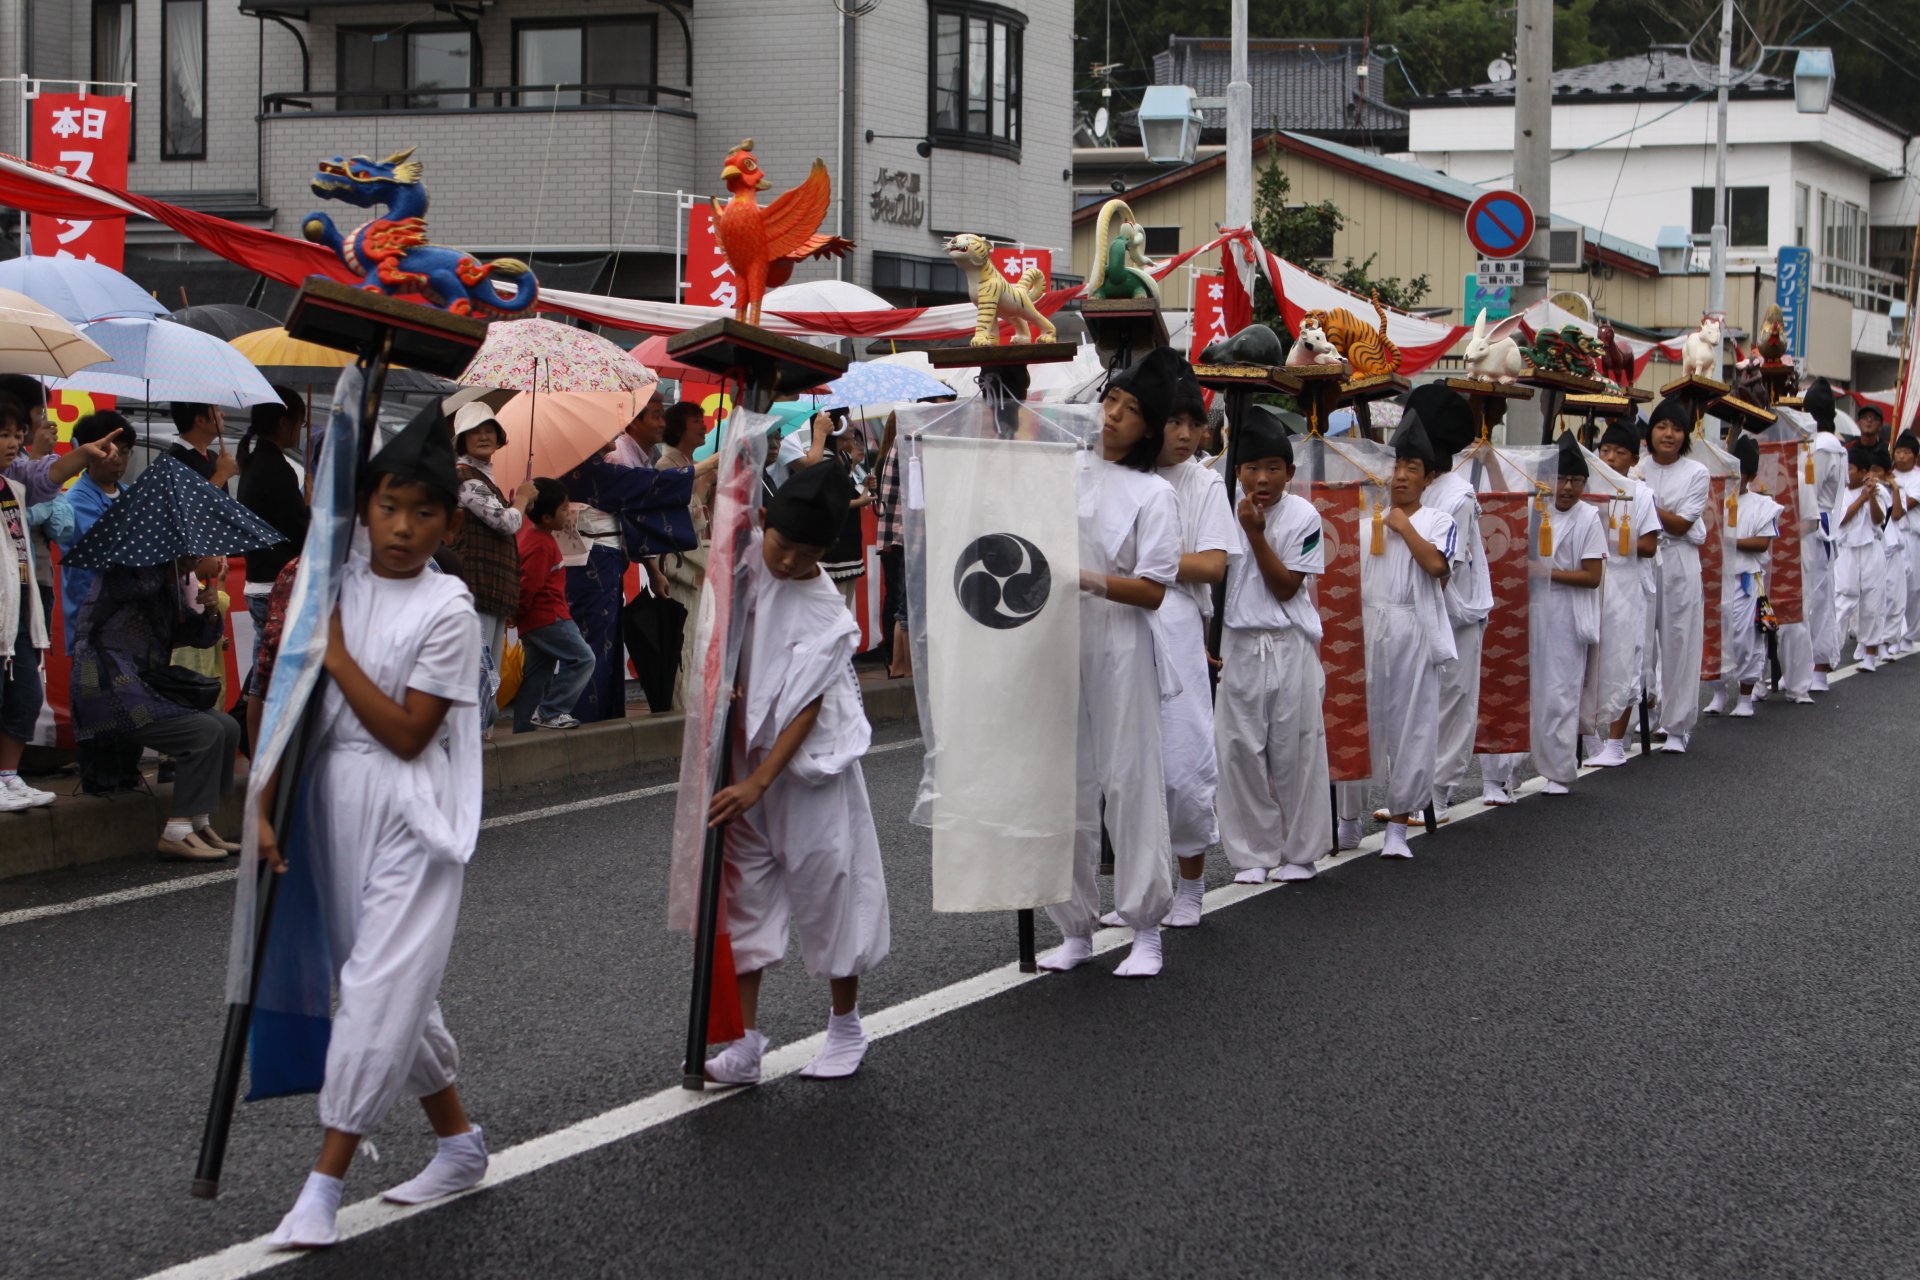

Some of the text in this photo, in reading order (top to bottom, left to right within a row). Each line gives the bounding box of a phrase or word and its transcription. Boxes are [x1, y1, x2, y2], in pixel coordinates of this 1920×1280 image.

[51, 106, 107, 139] 本日
[1480, 262, 1520, 273] 自動車
